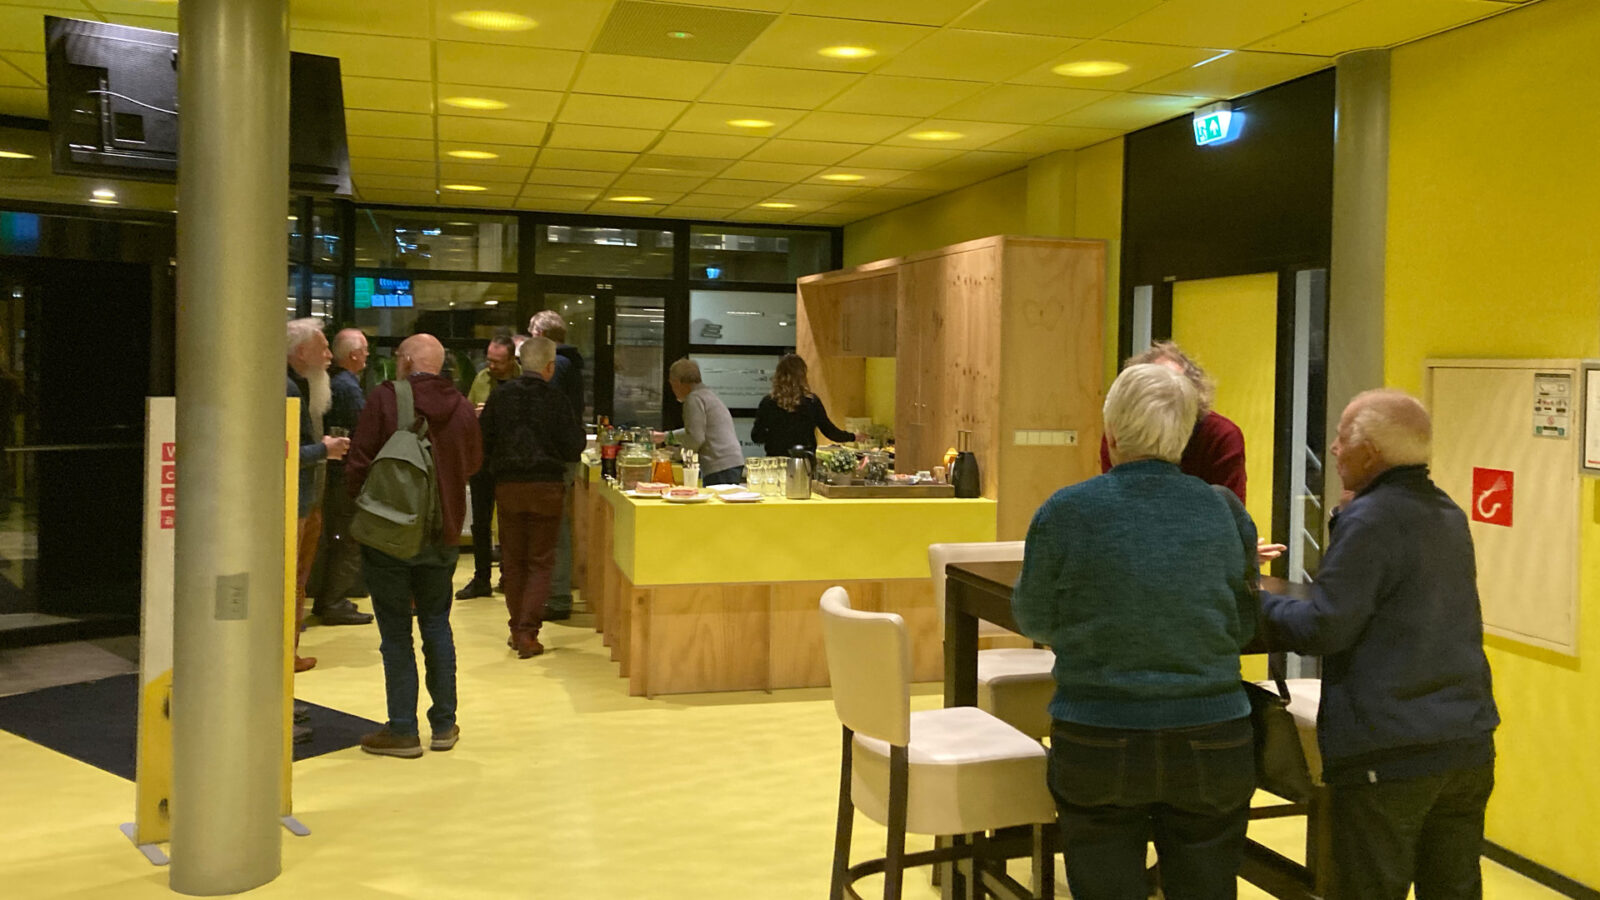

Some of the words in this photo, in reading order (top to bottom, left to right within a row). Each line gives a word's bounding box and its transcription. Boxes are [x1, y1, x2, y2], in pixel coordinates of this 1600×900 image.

[165, 471, 175, 481] c
[165, 493, 175, 503] e
[164, 516, 174, 525] a
